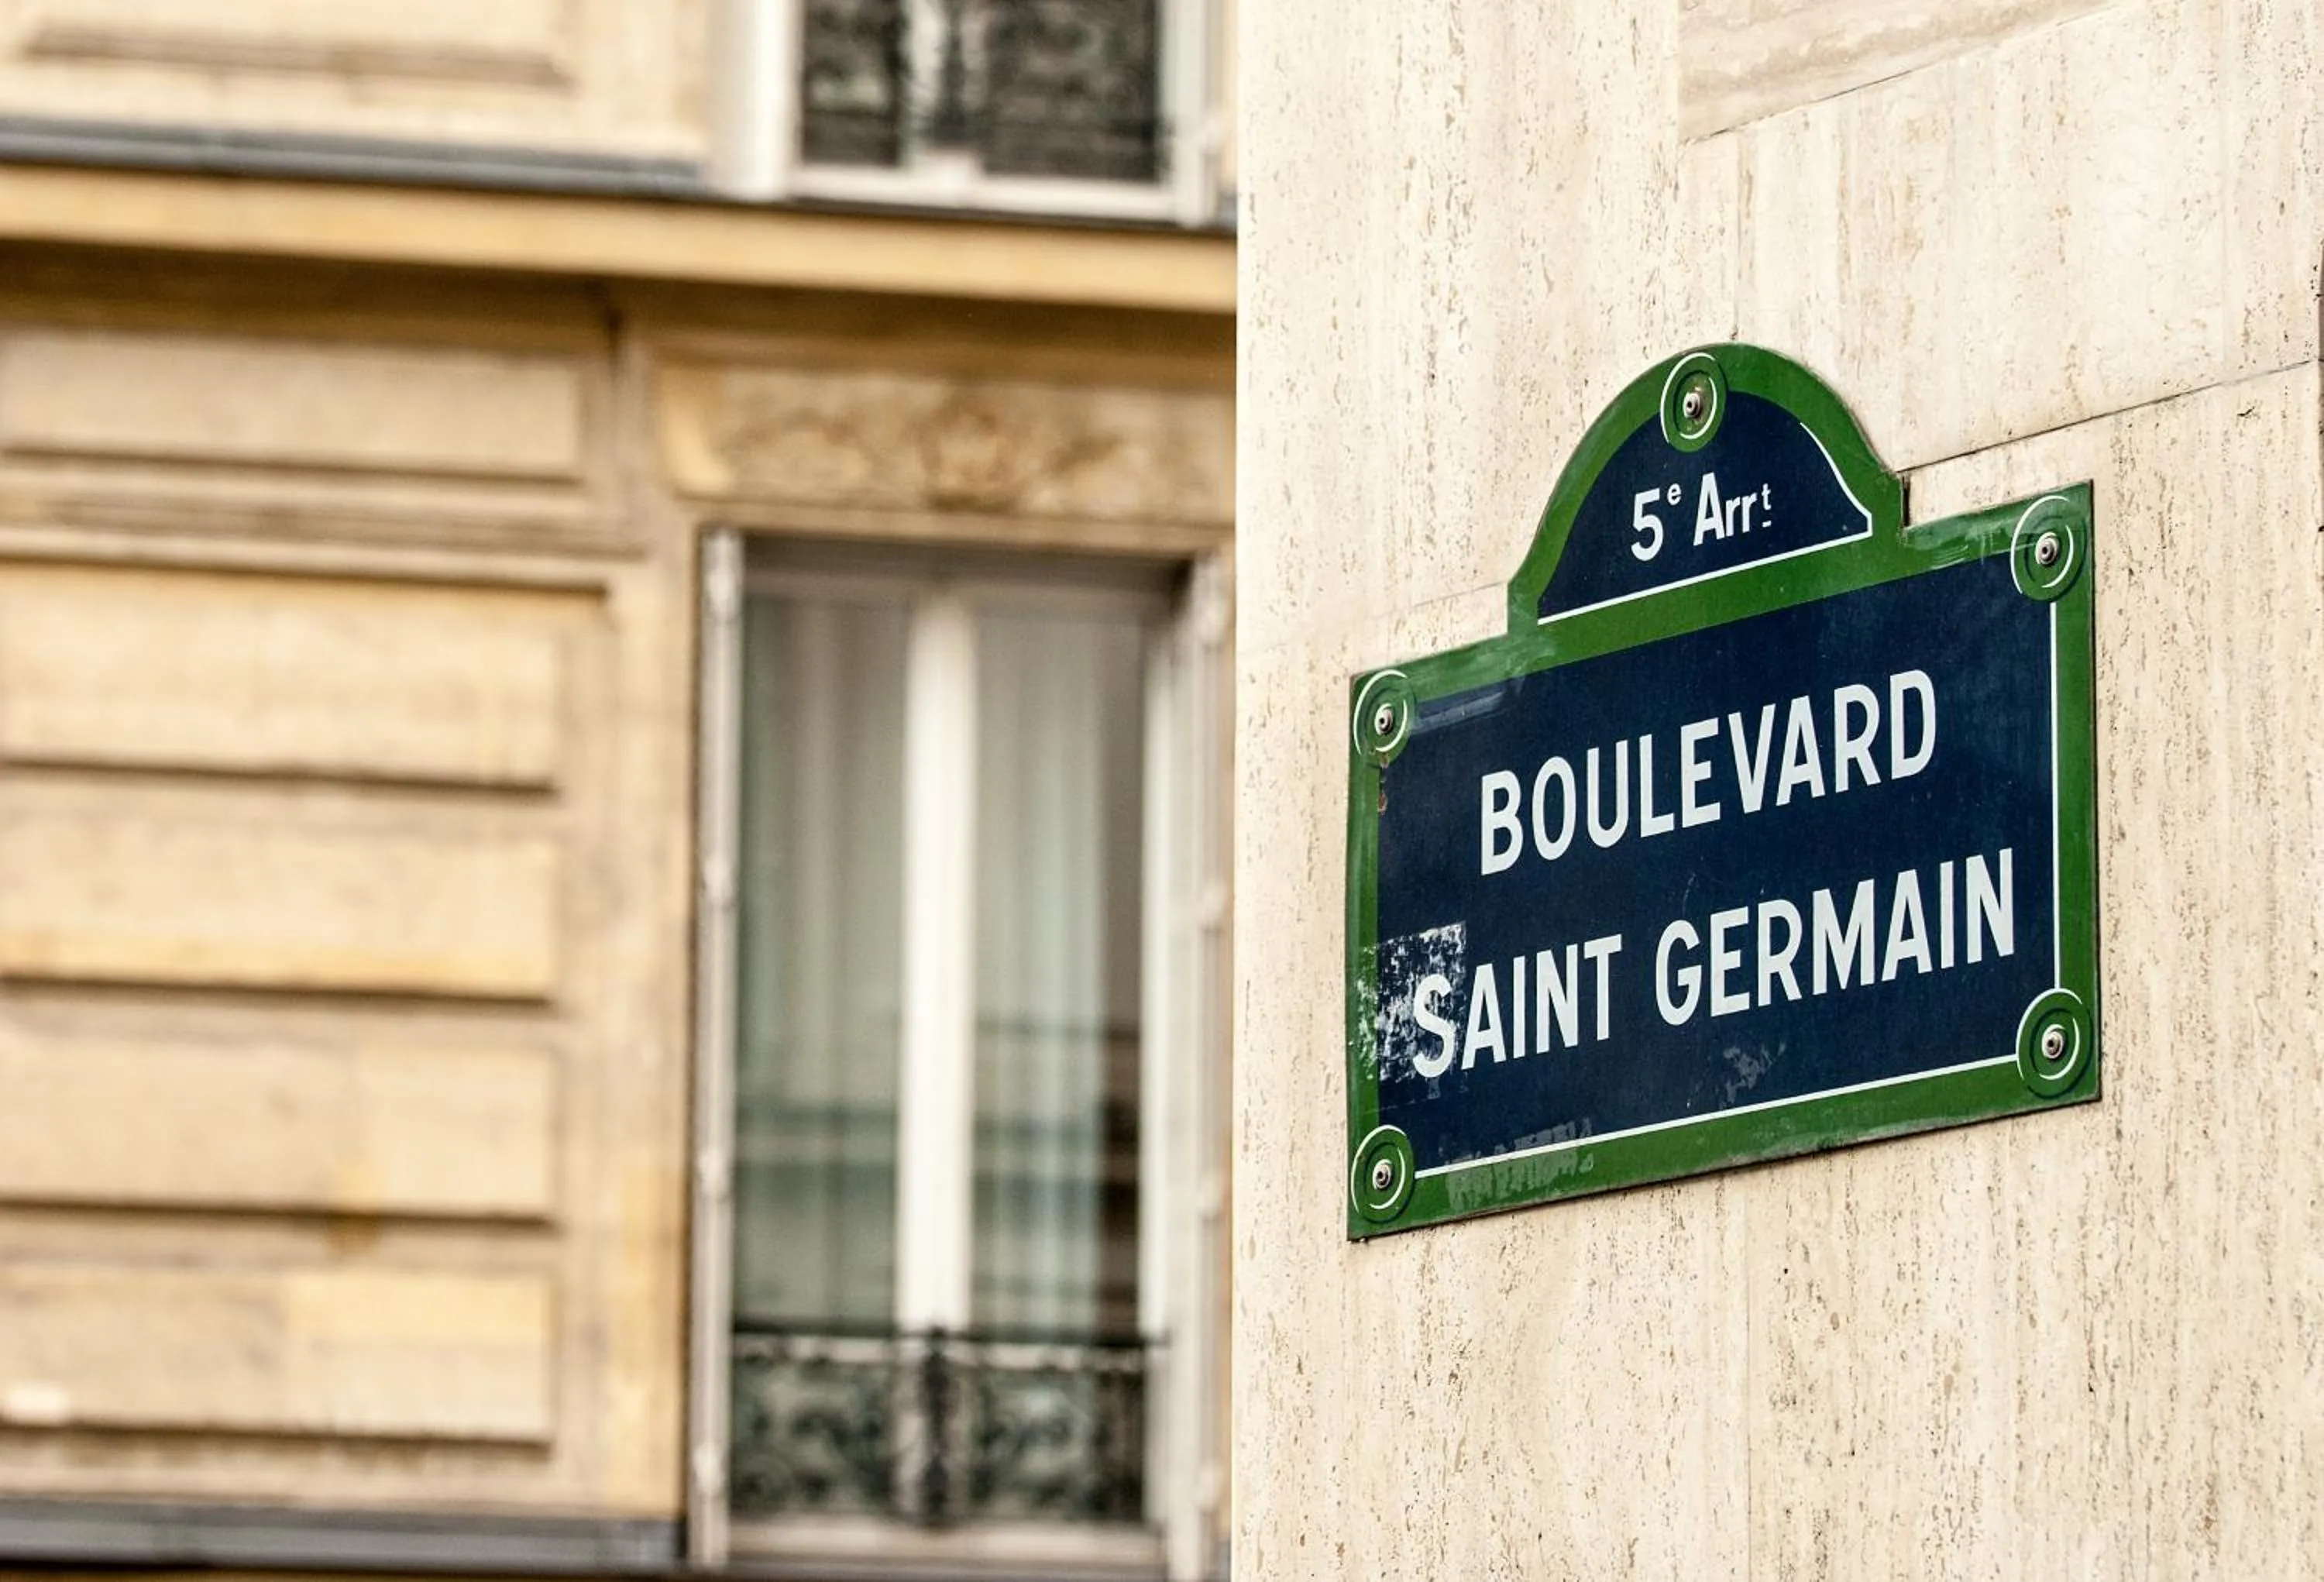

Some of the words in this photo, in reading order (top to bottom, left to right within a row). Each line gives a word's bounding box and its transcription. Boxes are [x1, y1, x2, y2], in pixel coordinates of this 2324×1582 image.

[1480, 669, 1937, 876] BOULEVARD
[1412, 934, 1622, 1078] SAINT
[1655, 848, 2014, 1026] GERMAIN
